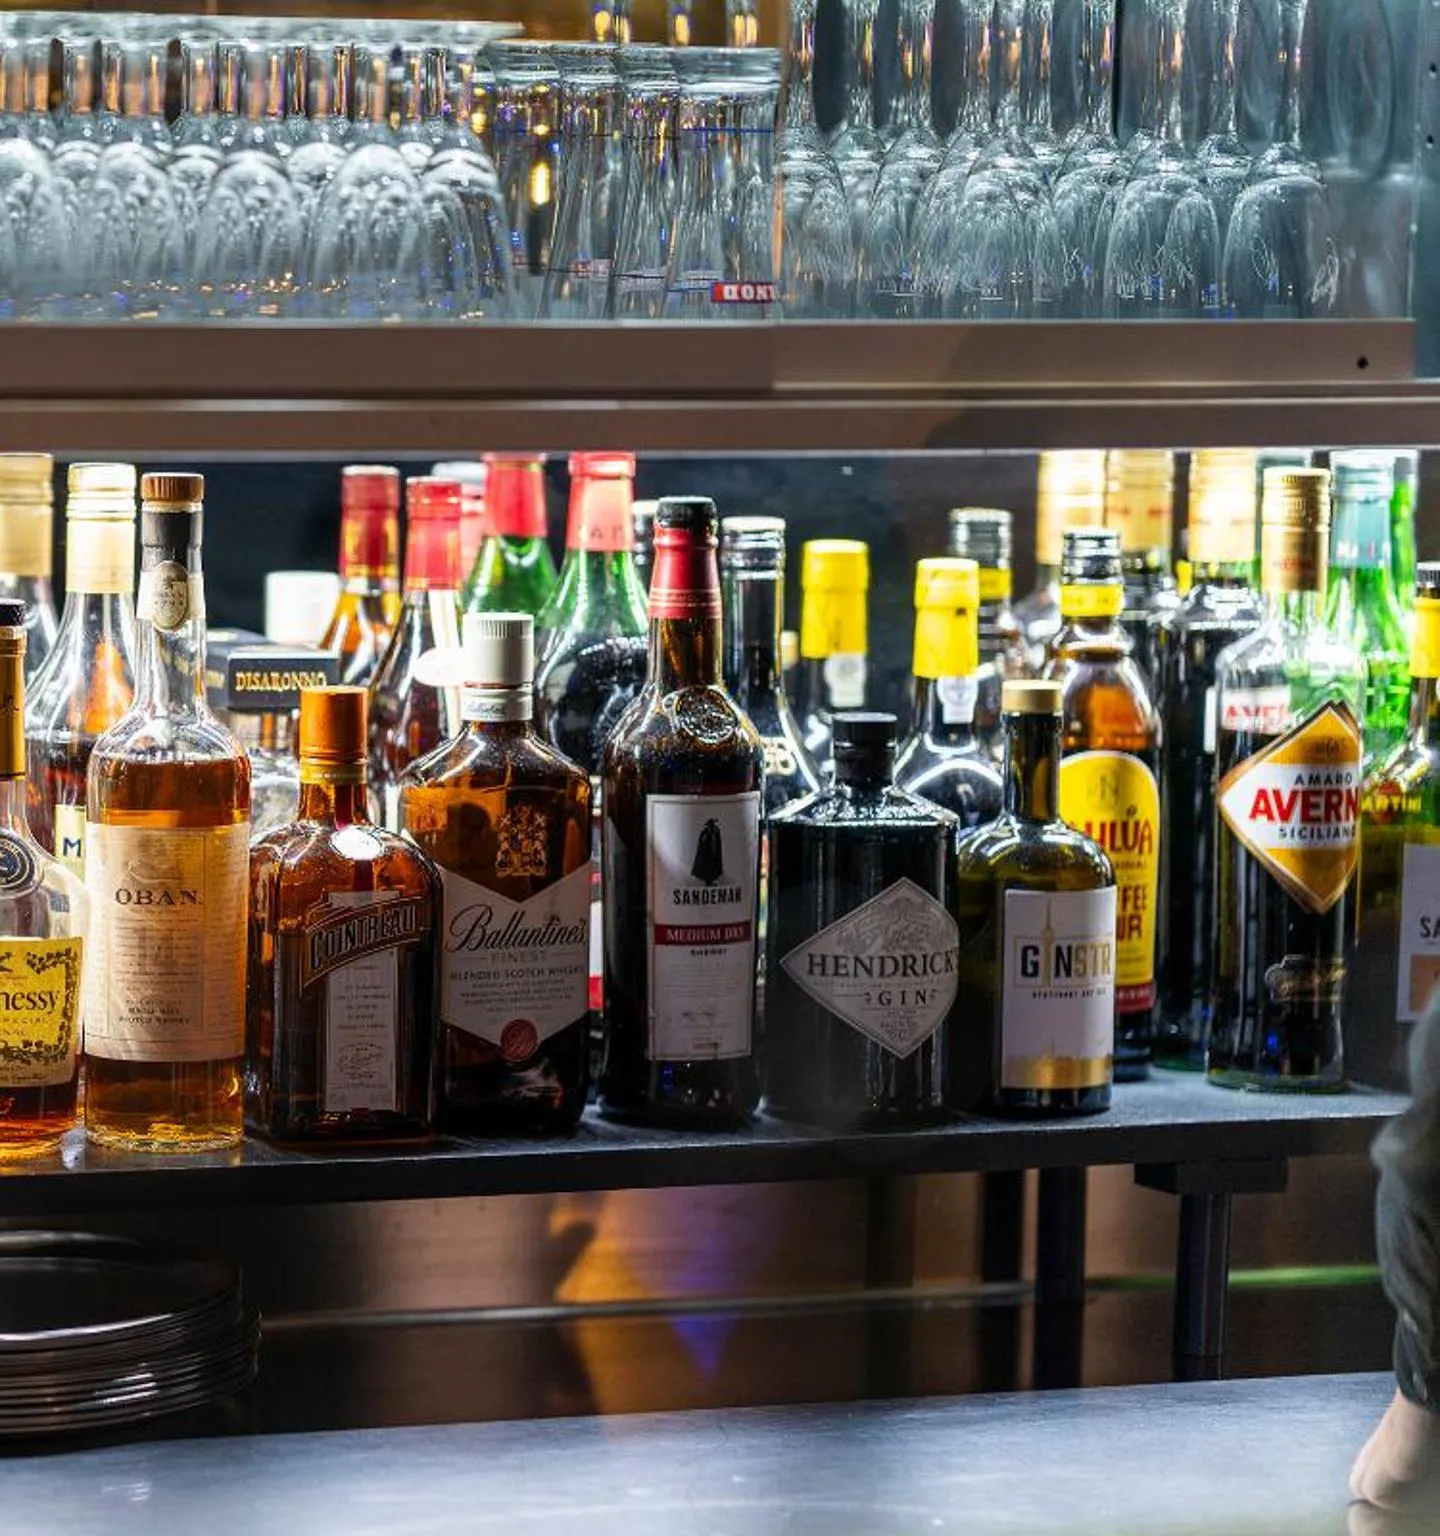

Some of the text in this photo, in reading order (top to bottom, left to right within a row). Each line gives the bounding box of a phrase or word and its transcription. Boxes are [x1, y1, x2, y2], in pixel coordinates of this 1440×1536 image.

[235, 670, 327, 691] DISARONNO
[1295, 771, 1353, 785] AMARO
[115, 888, 200, 906] OBAN
[673, 887, 742, 906] SANDEMAN
[311, 905, 417, 971] COINTREAU
[666, 927, 721, 941] MEDIUM
[878, 990, 927, 1006] GIN
